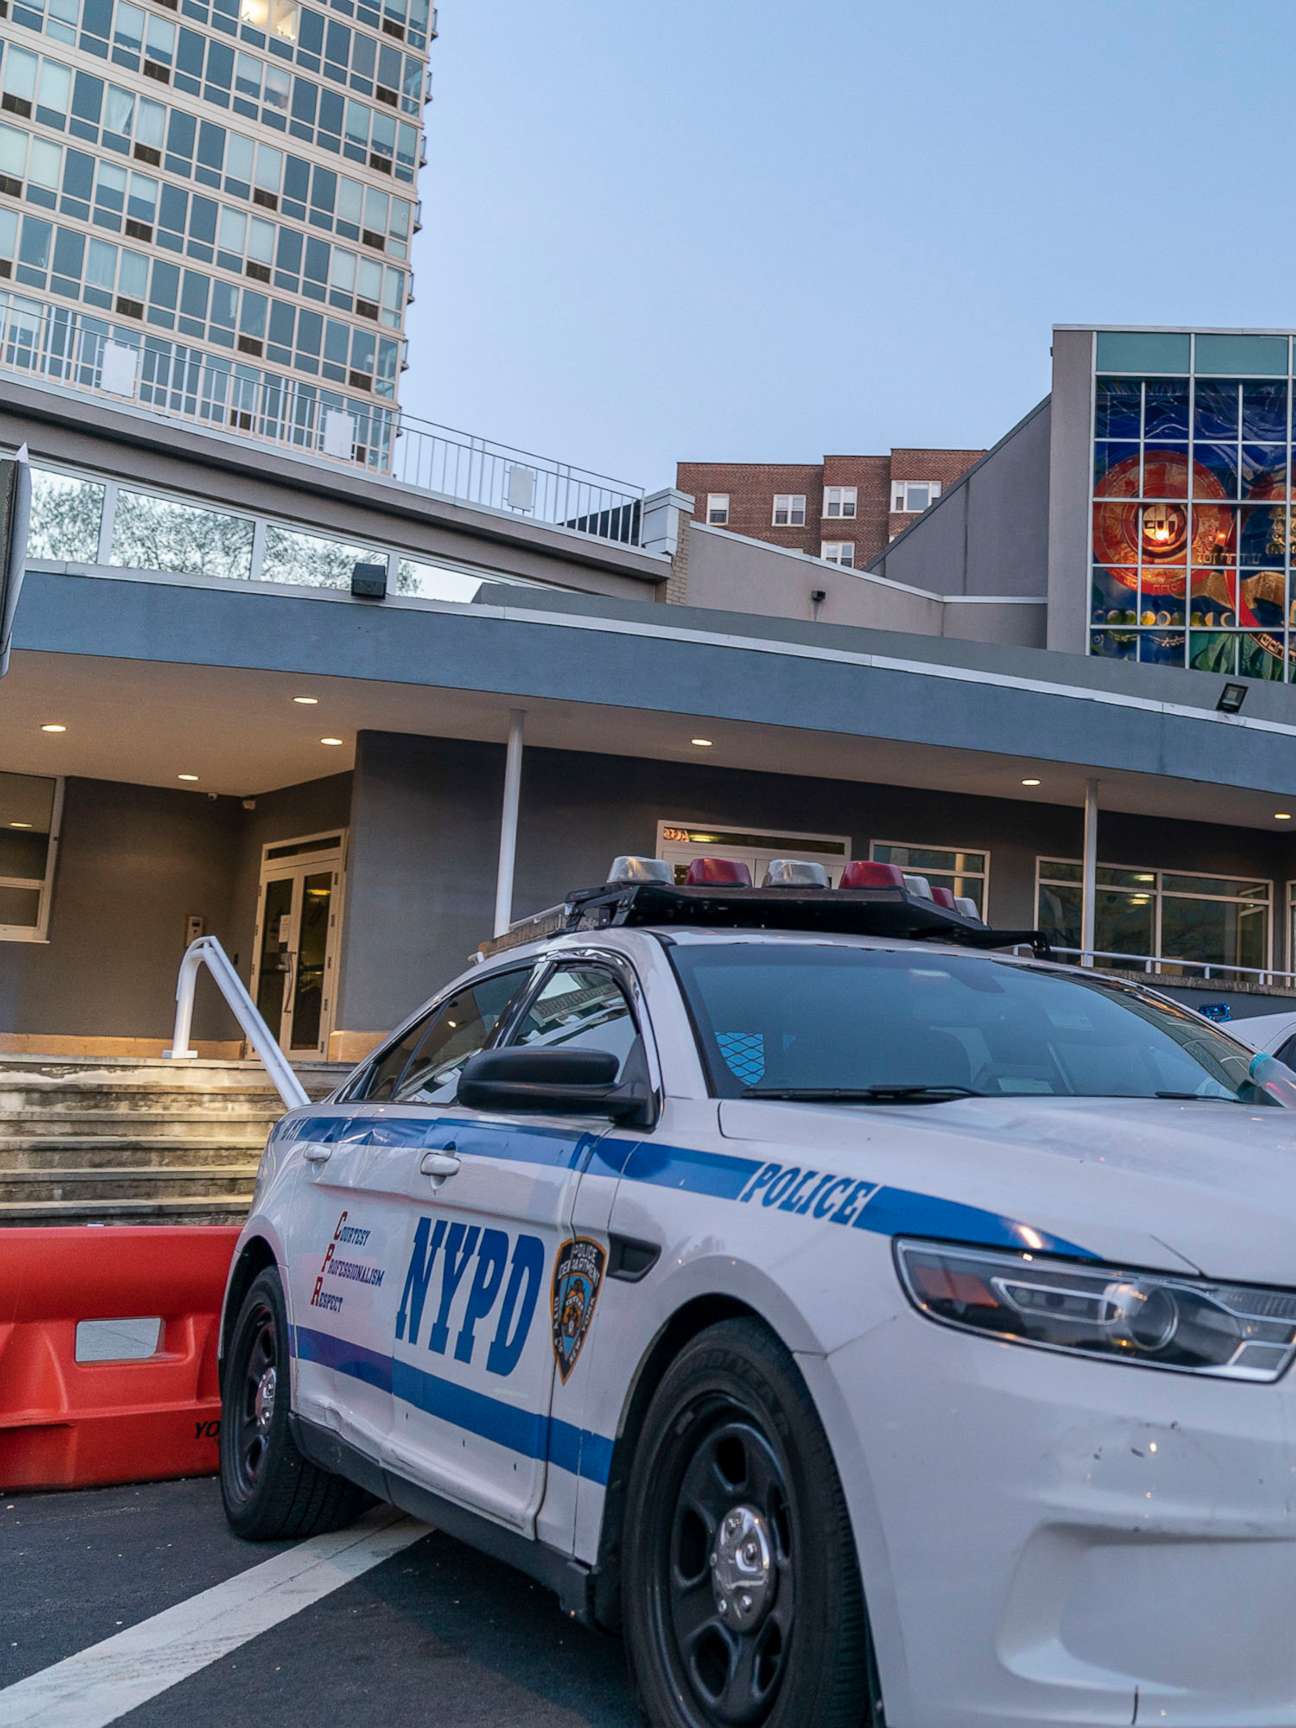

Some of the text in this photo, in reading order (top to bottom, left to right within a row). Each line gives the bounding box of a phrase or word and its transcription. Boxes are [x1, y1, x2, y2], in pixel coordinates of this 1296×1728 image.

[740, 1163, 878, 1226] POLICE
[334, 1211, 371, 1246] COURTESY
[321, 1243, 385, 1287] PROFESSIONALISM
[310, 1276, 344, 1312] RESPECT
[395, 1216, 545, 1377] NYPD
[195, 1421, 221, 1440] YO
